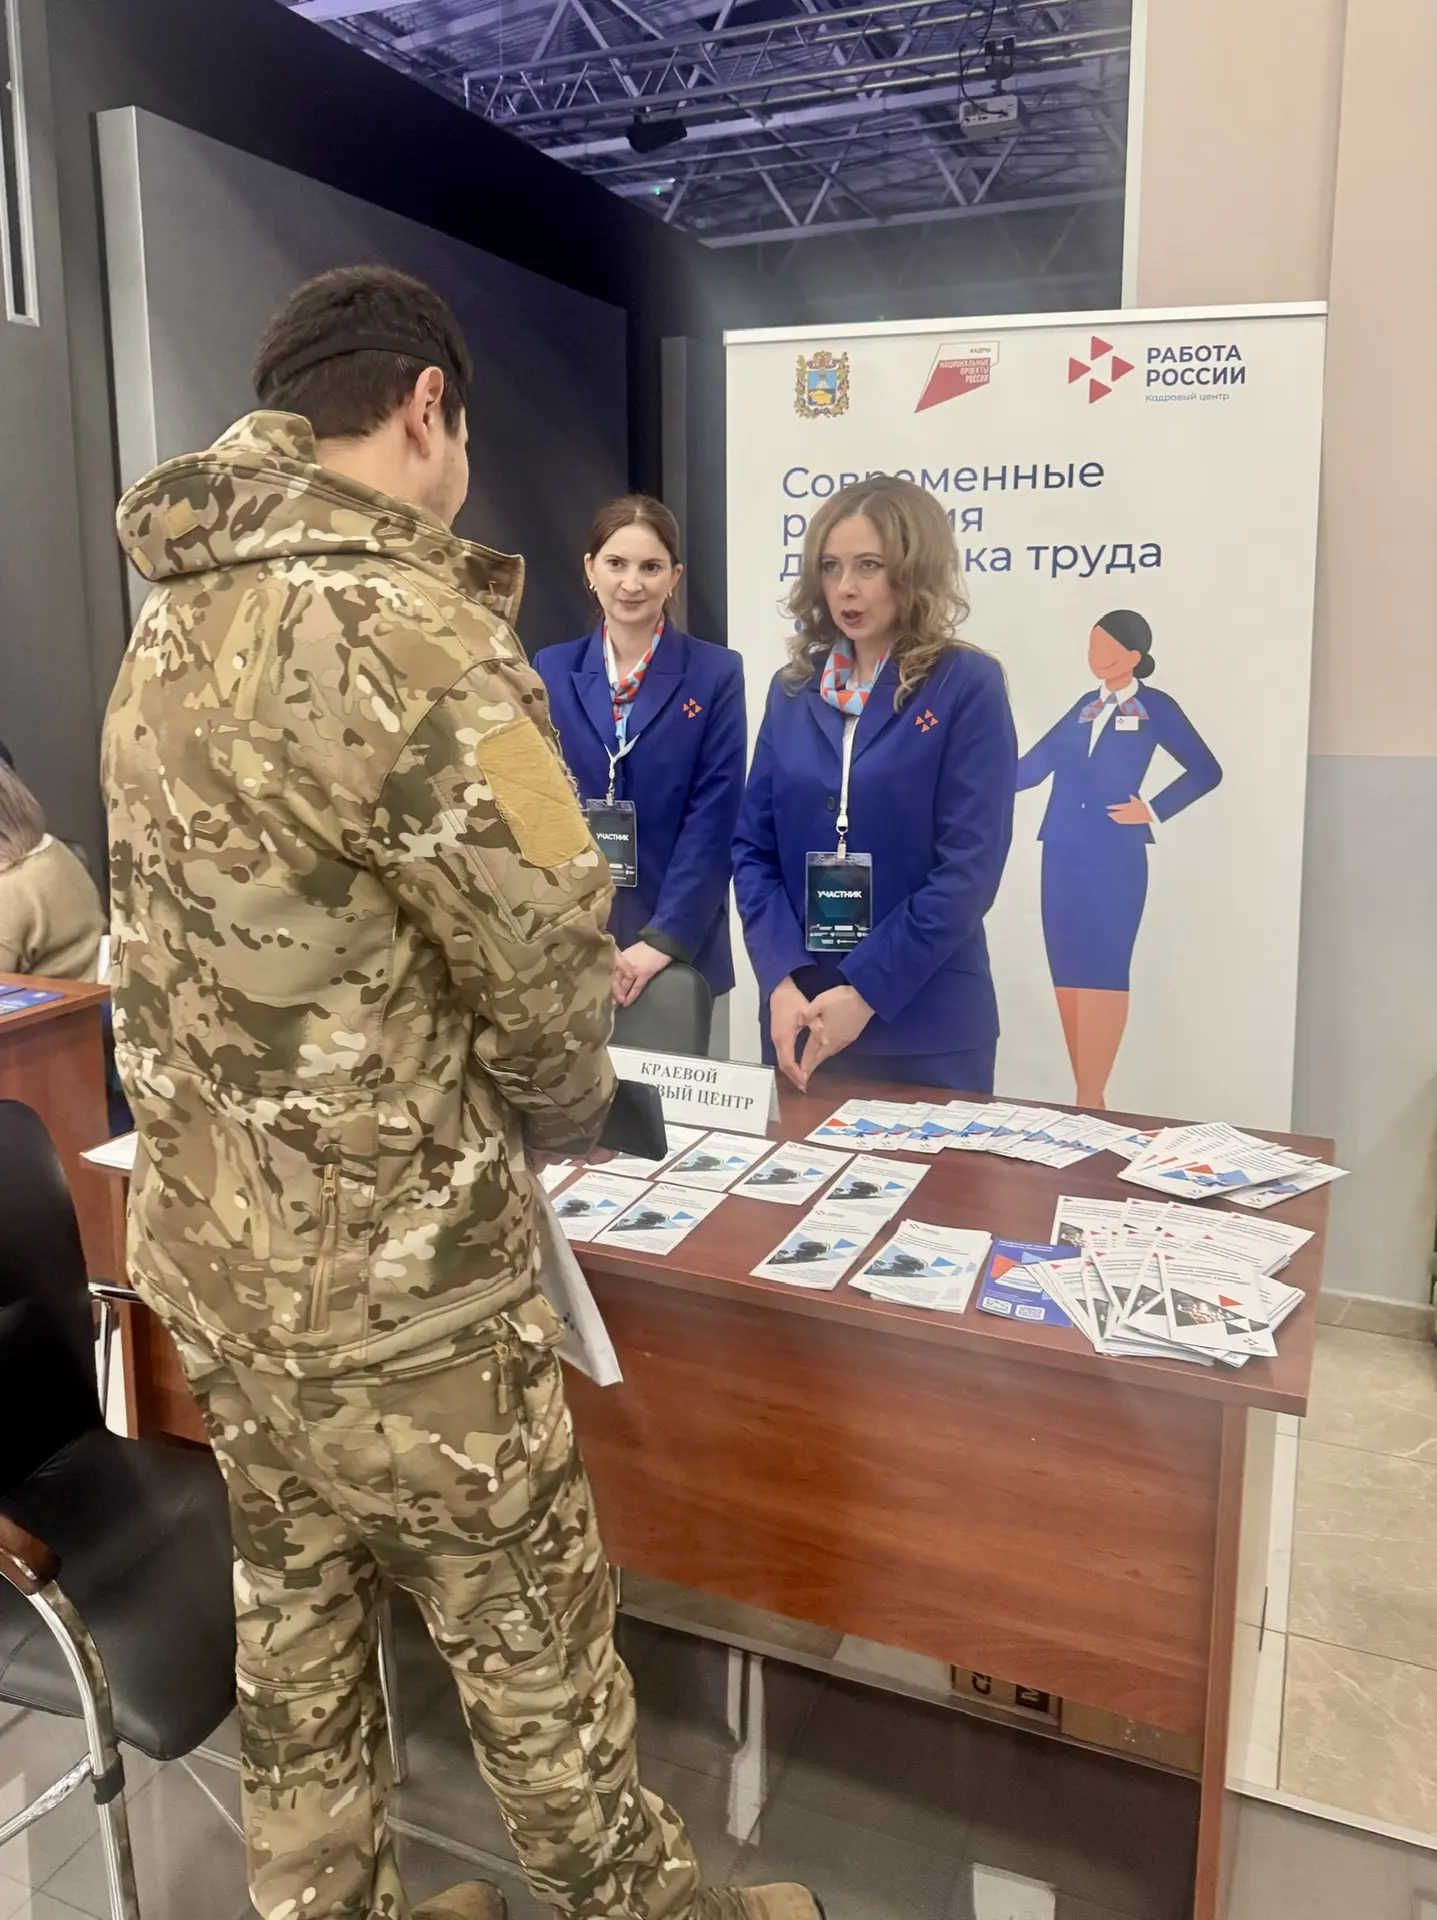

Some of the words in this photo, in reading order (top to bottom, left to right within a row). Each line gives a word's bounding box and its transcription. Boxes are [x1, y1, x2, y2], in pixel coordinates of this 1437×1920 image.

[1146, 344, 1243, 364] РАБОТА
[1145, 366, 1247, 387] РОССИИ
[1145, 392, 1197, 403] Кадровый
[1199, 392, 1230, 402] центр
[781, 461, 1105, 499] Соменные
[1027, 541, 1162, 578] труда
[595, 832, 629, 841] УЧАСТНИК
[816, 890, 862, 898] УЧАСТНИК
[640, 1062, 718, 1084] КРАЕВОЙ
[697, 1089, 755, 1110] ЦЕНТР
